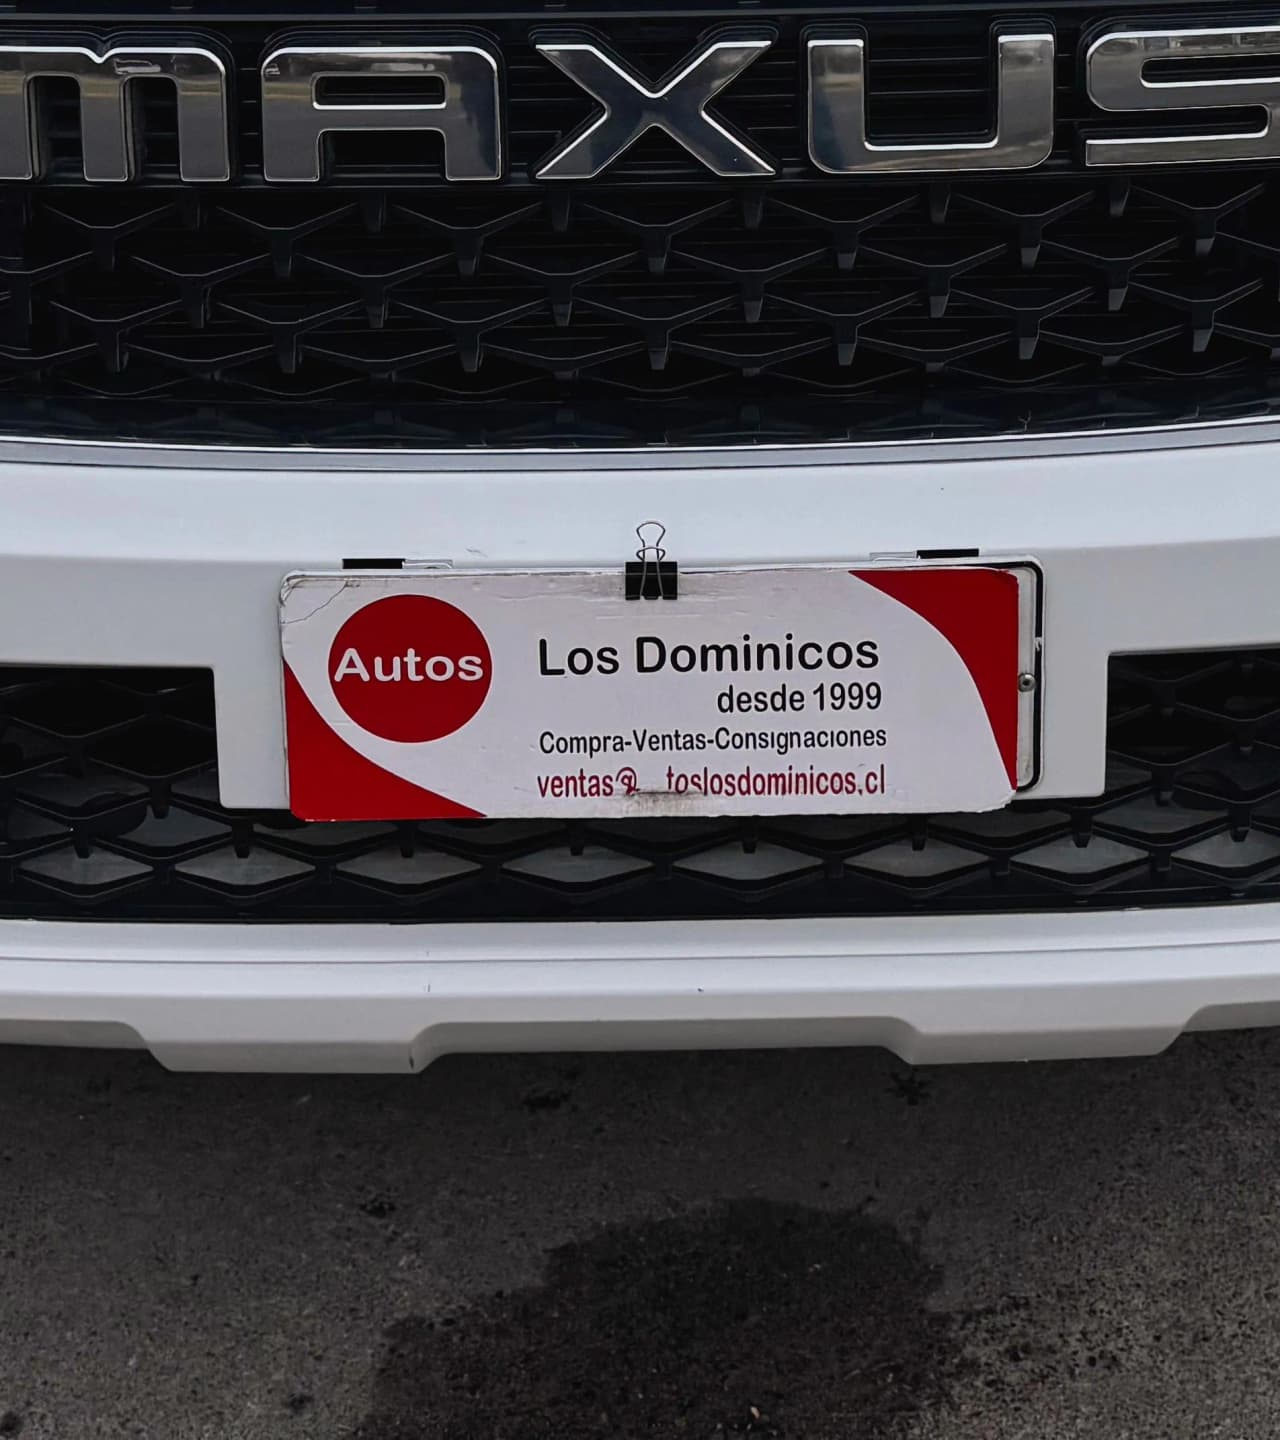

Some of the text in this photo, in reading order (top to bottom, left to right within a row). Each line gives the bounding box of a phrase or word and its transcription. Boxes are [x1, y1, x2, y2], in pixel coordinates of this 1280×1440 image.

[333, 646, 485, 684] Autos
[538, 635, 879, 677] Los Dominicos
[717, 681, 883, 713] desde 1999
[539, 726, 888, 758] Compra-Ventas-Consignaciones
